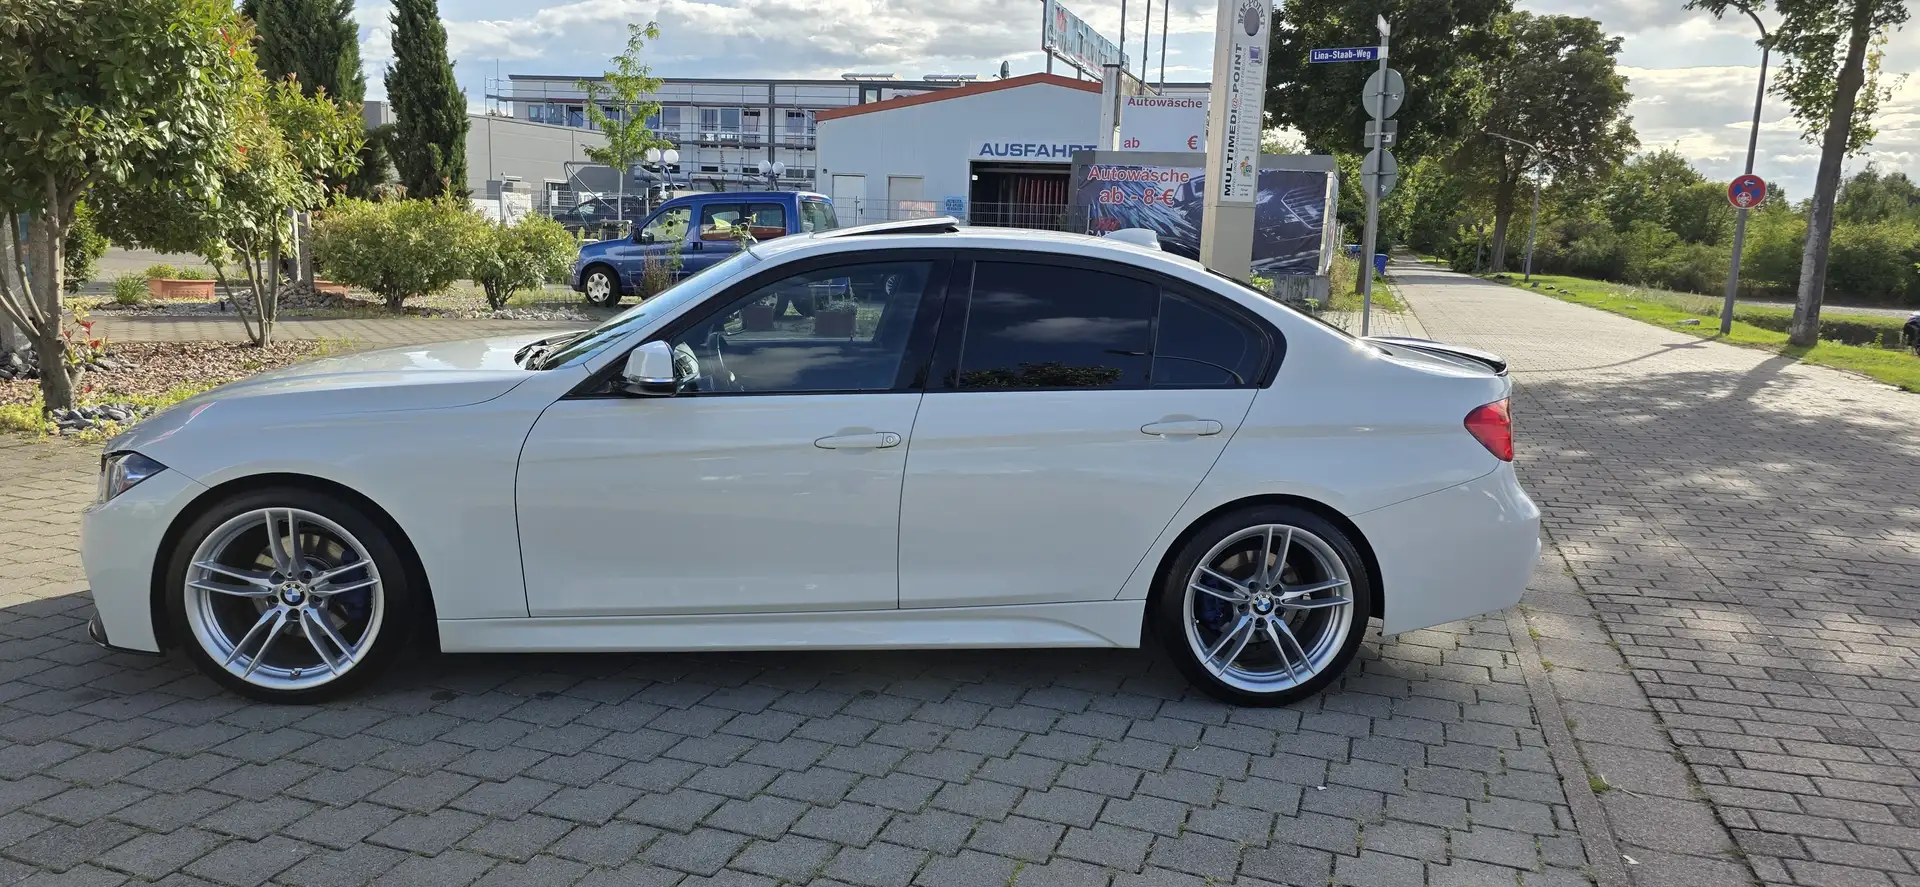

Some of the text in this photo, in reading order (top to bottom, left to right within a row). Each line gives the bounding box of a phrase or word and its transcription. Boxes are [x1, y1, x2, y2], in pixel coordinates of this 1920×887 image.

[1314, 49, 1371, 60] Lina-Staab-Weg
[1127, 96, 1203, 109] Autowäsche
[1223, 42, 1242, 197] MULTIMEDI@-POINT
[1124, 135, 1199, 150] ab €
[1087, 165, 1190, 183] Autowäsche
[1099, 186, 1124, 204] ab
